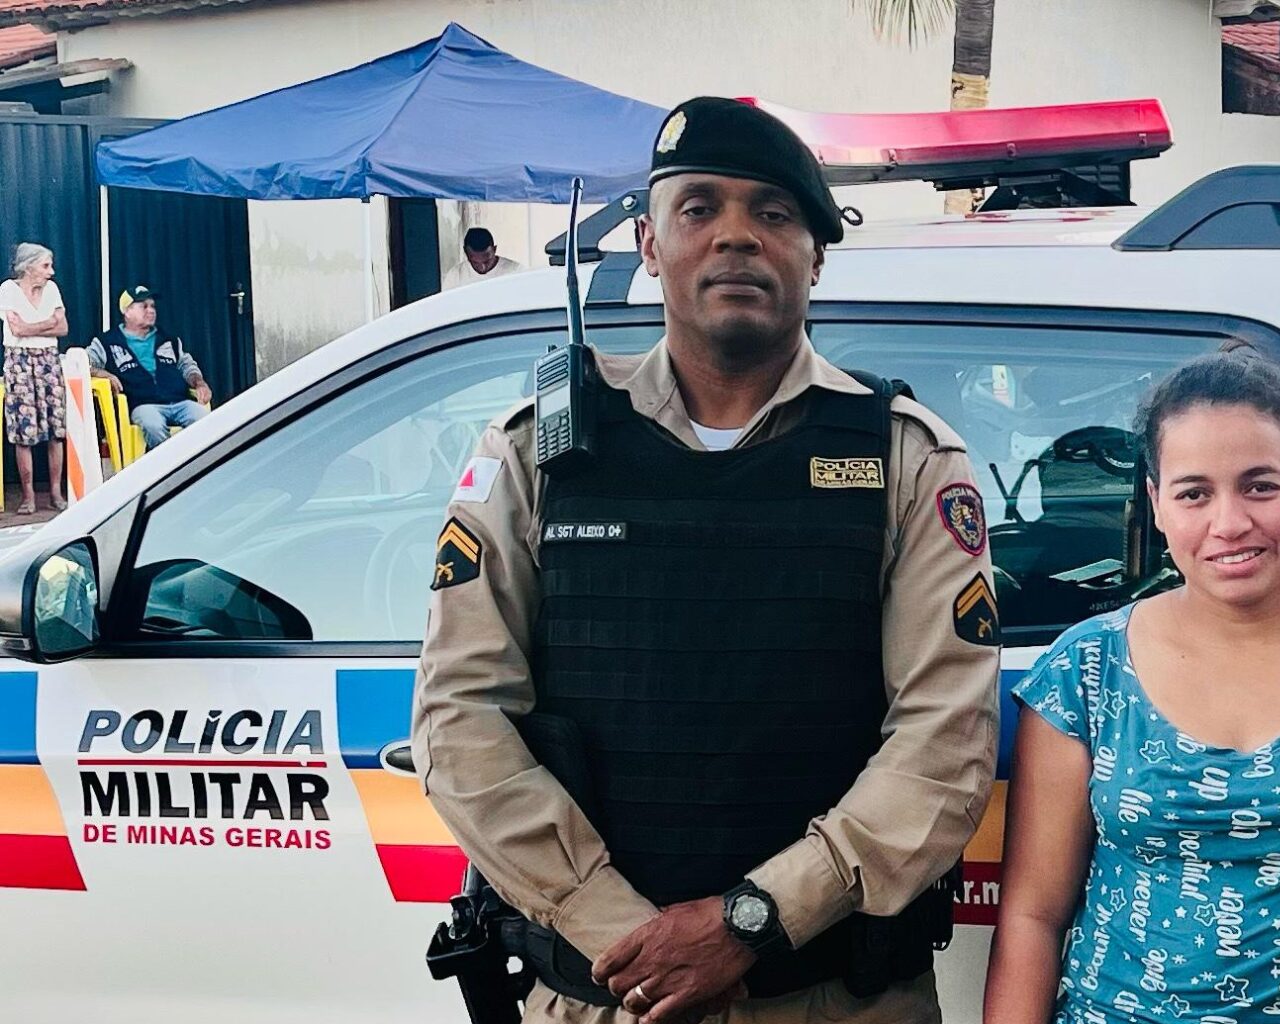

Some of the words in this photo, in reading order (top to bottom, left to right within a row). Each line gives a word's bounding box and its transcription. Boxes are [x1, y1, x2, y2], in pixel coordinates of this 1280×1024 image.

[815, 471, 879, 481] MILITAR
[557, 525, 574, 538] SGT
[78, 709, 324, 755] POLÍCIA
[79, 771, 331, 821] MILITAR
[1187, 766, 1231, 802] up
[1117, 788, 1154, 823] life
[83, 823, 117, 844] DE
[127, 825, 216, 846] MINAS
[225, 827, 332, 850] GERAIS
[1128, 869, 1152, 943] never
[1215, 886, 1244, 958] never
